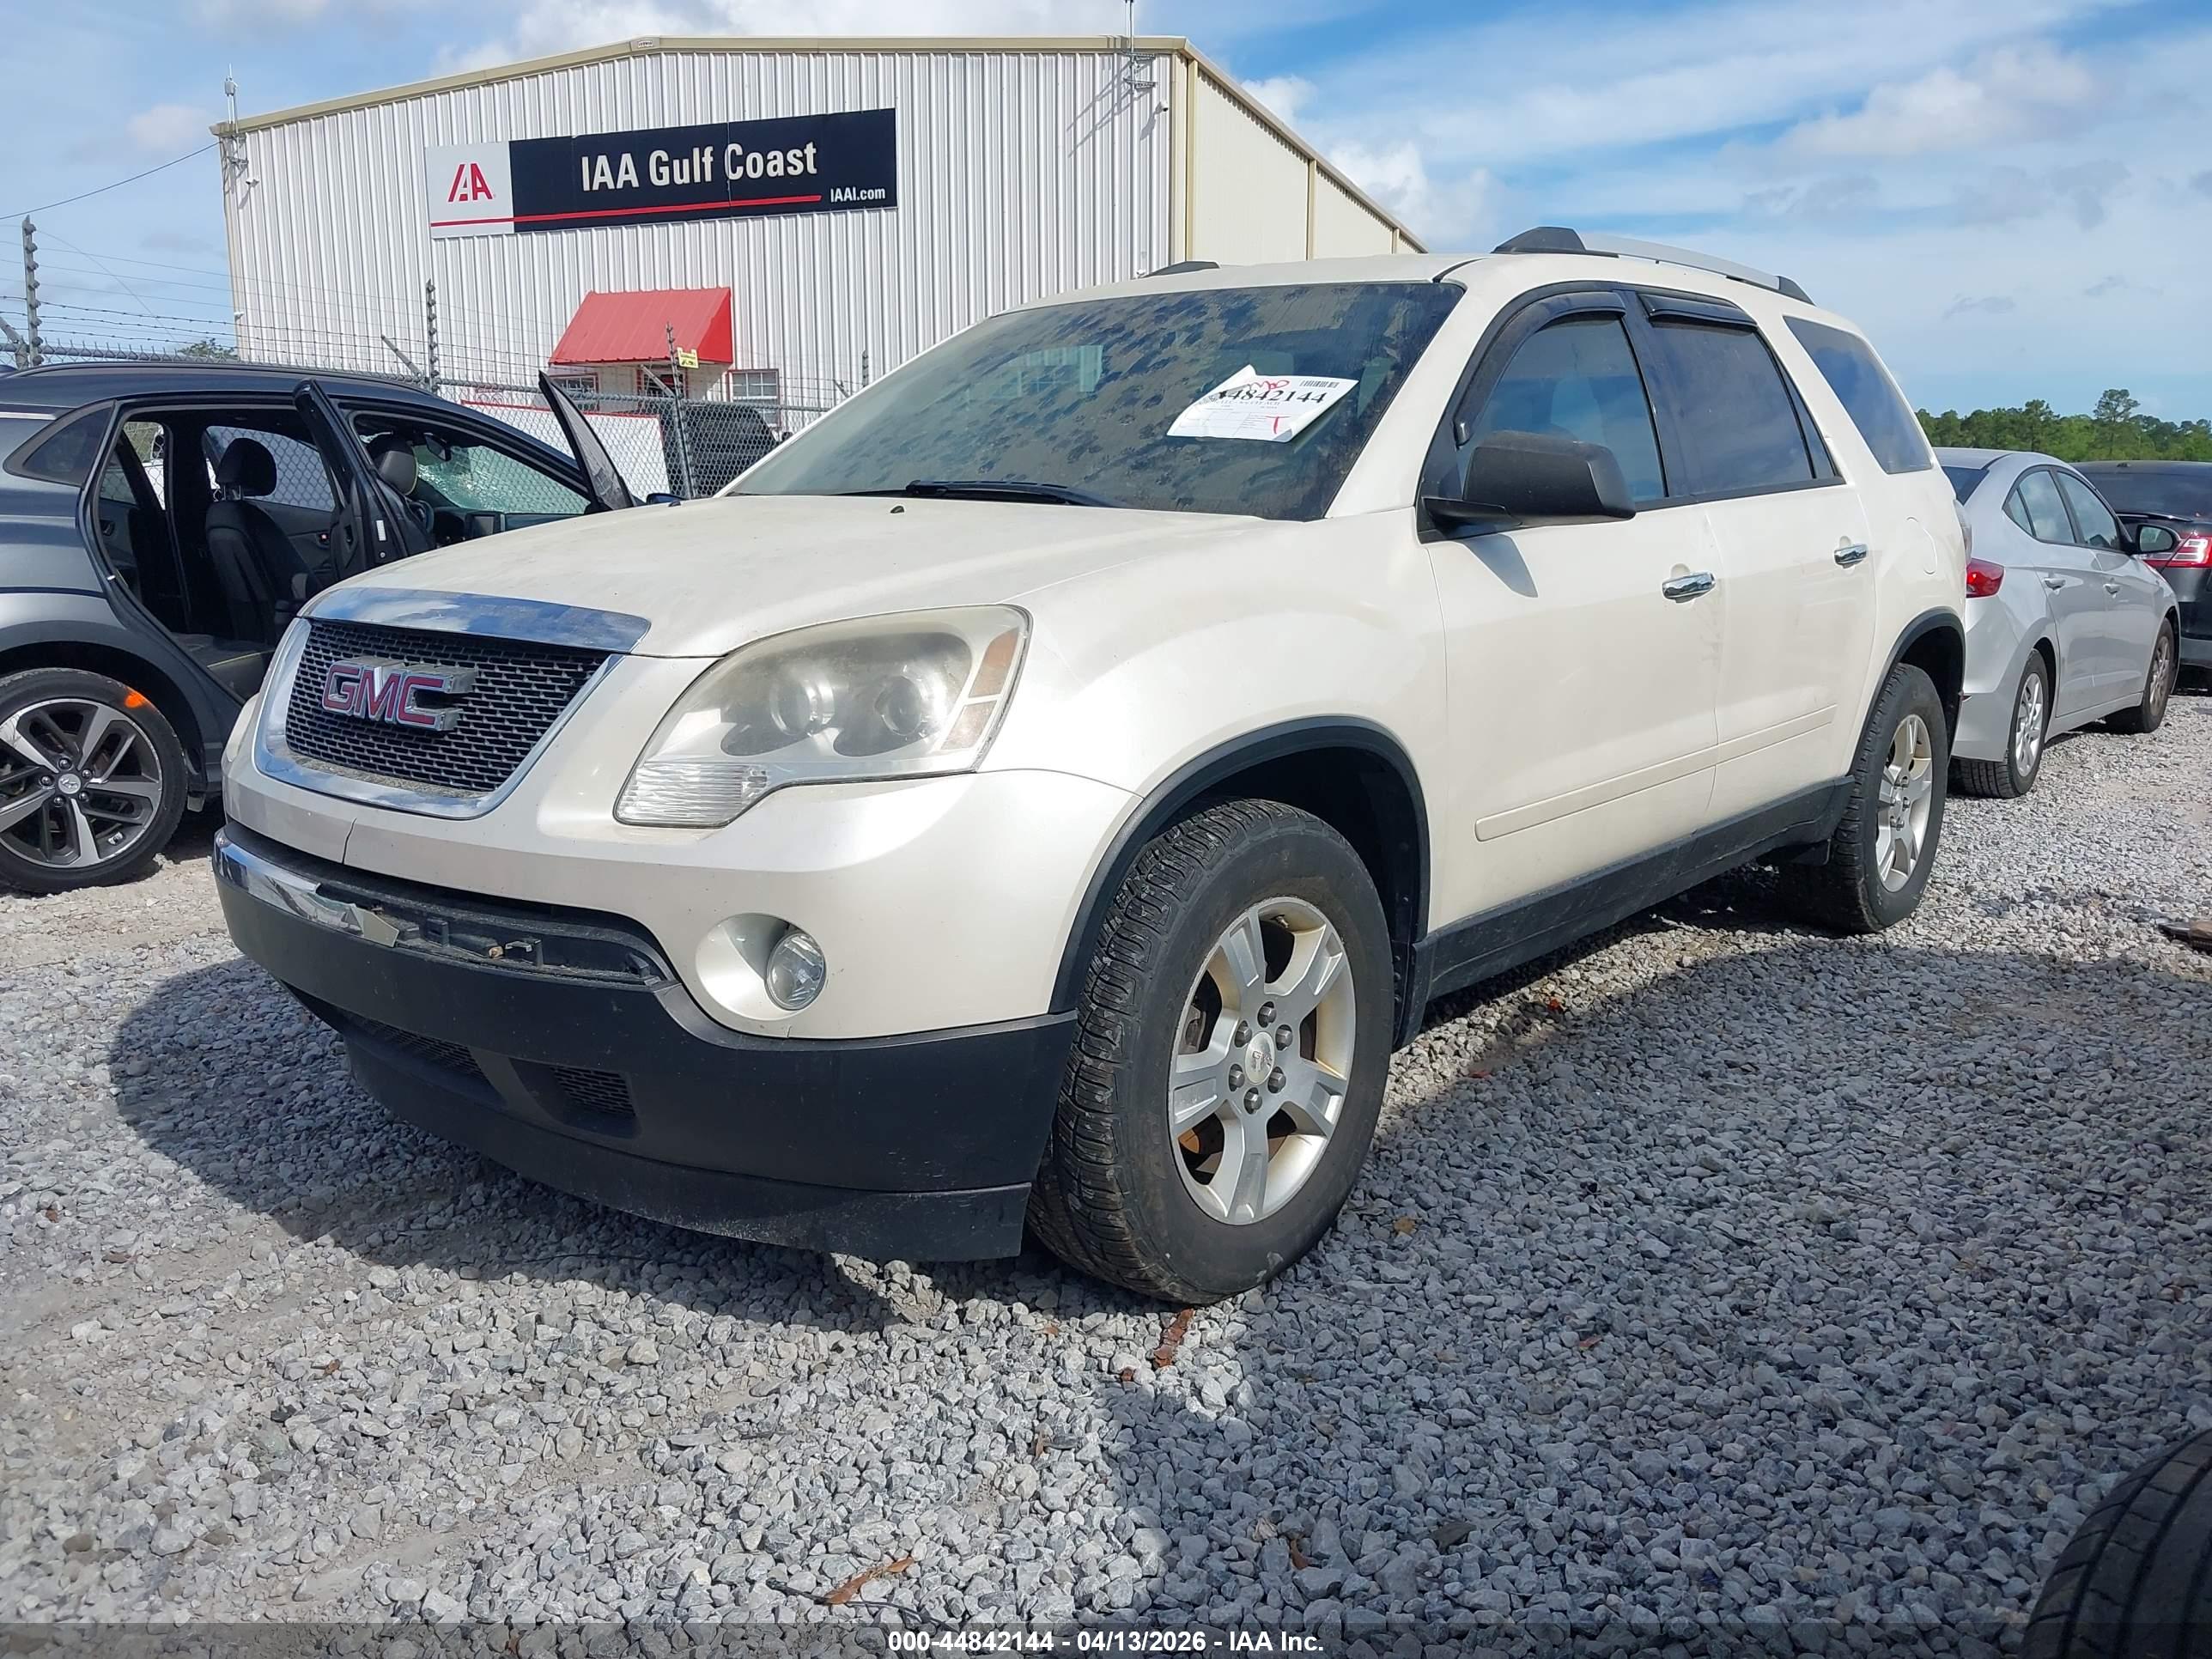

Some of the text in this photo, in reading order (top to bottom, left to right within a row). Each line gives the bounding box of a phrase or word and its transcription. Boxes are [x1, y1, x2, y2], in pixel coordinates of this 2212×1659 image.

[580, 141, 817, 191] IAA Gulf Coast
[830, 185, 887, 203] IAAI.com
[322, 659, 460, 732] GMC
